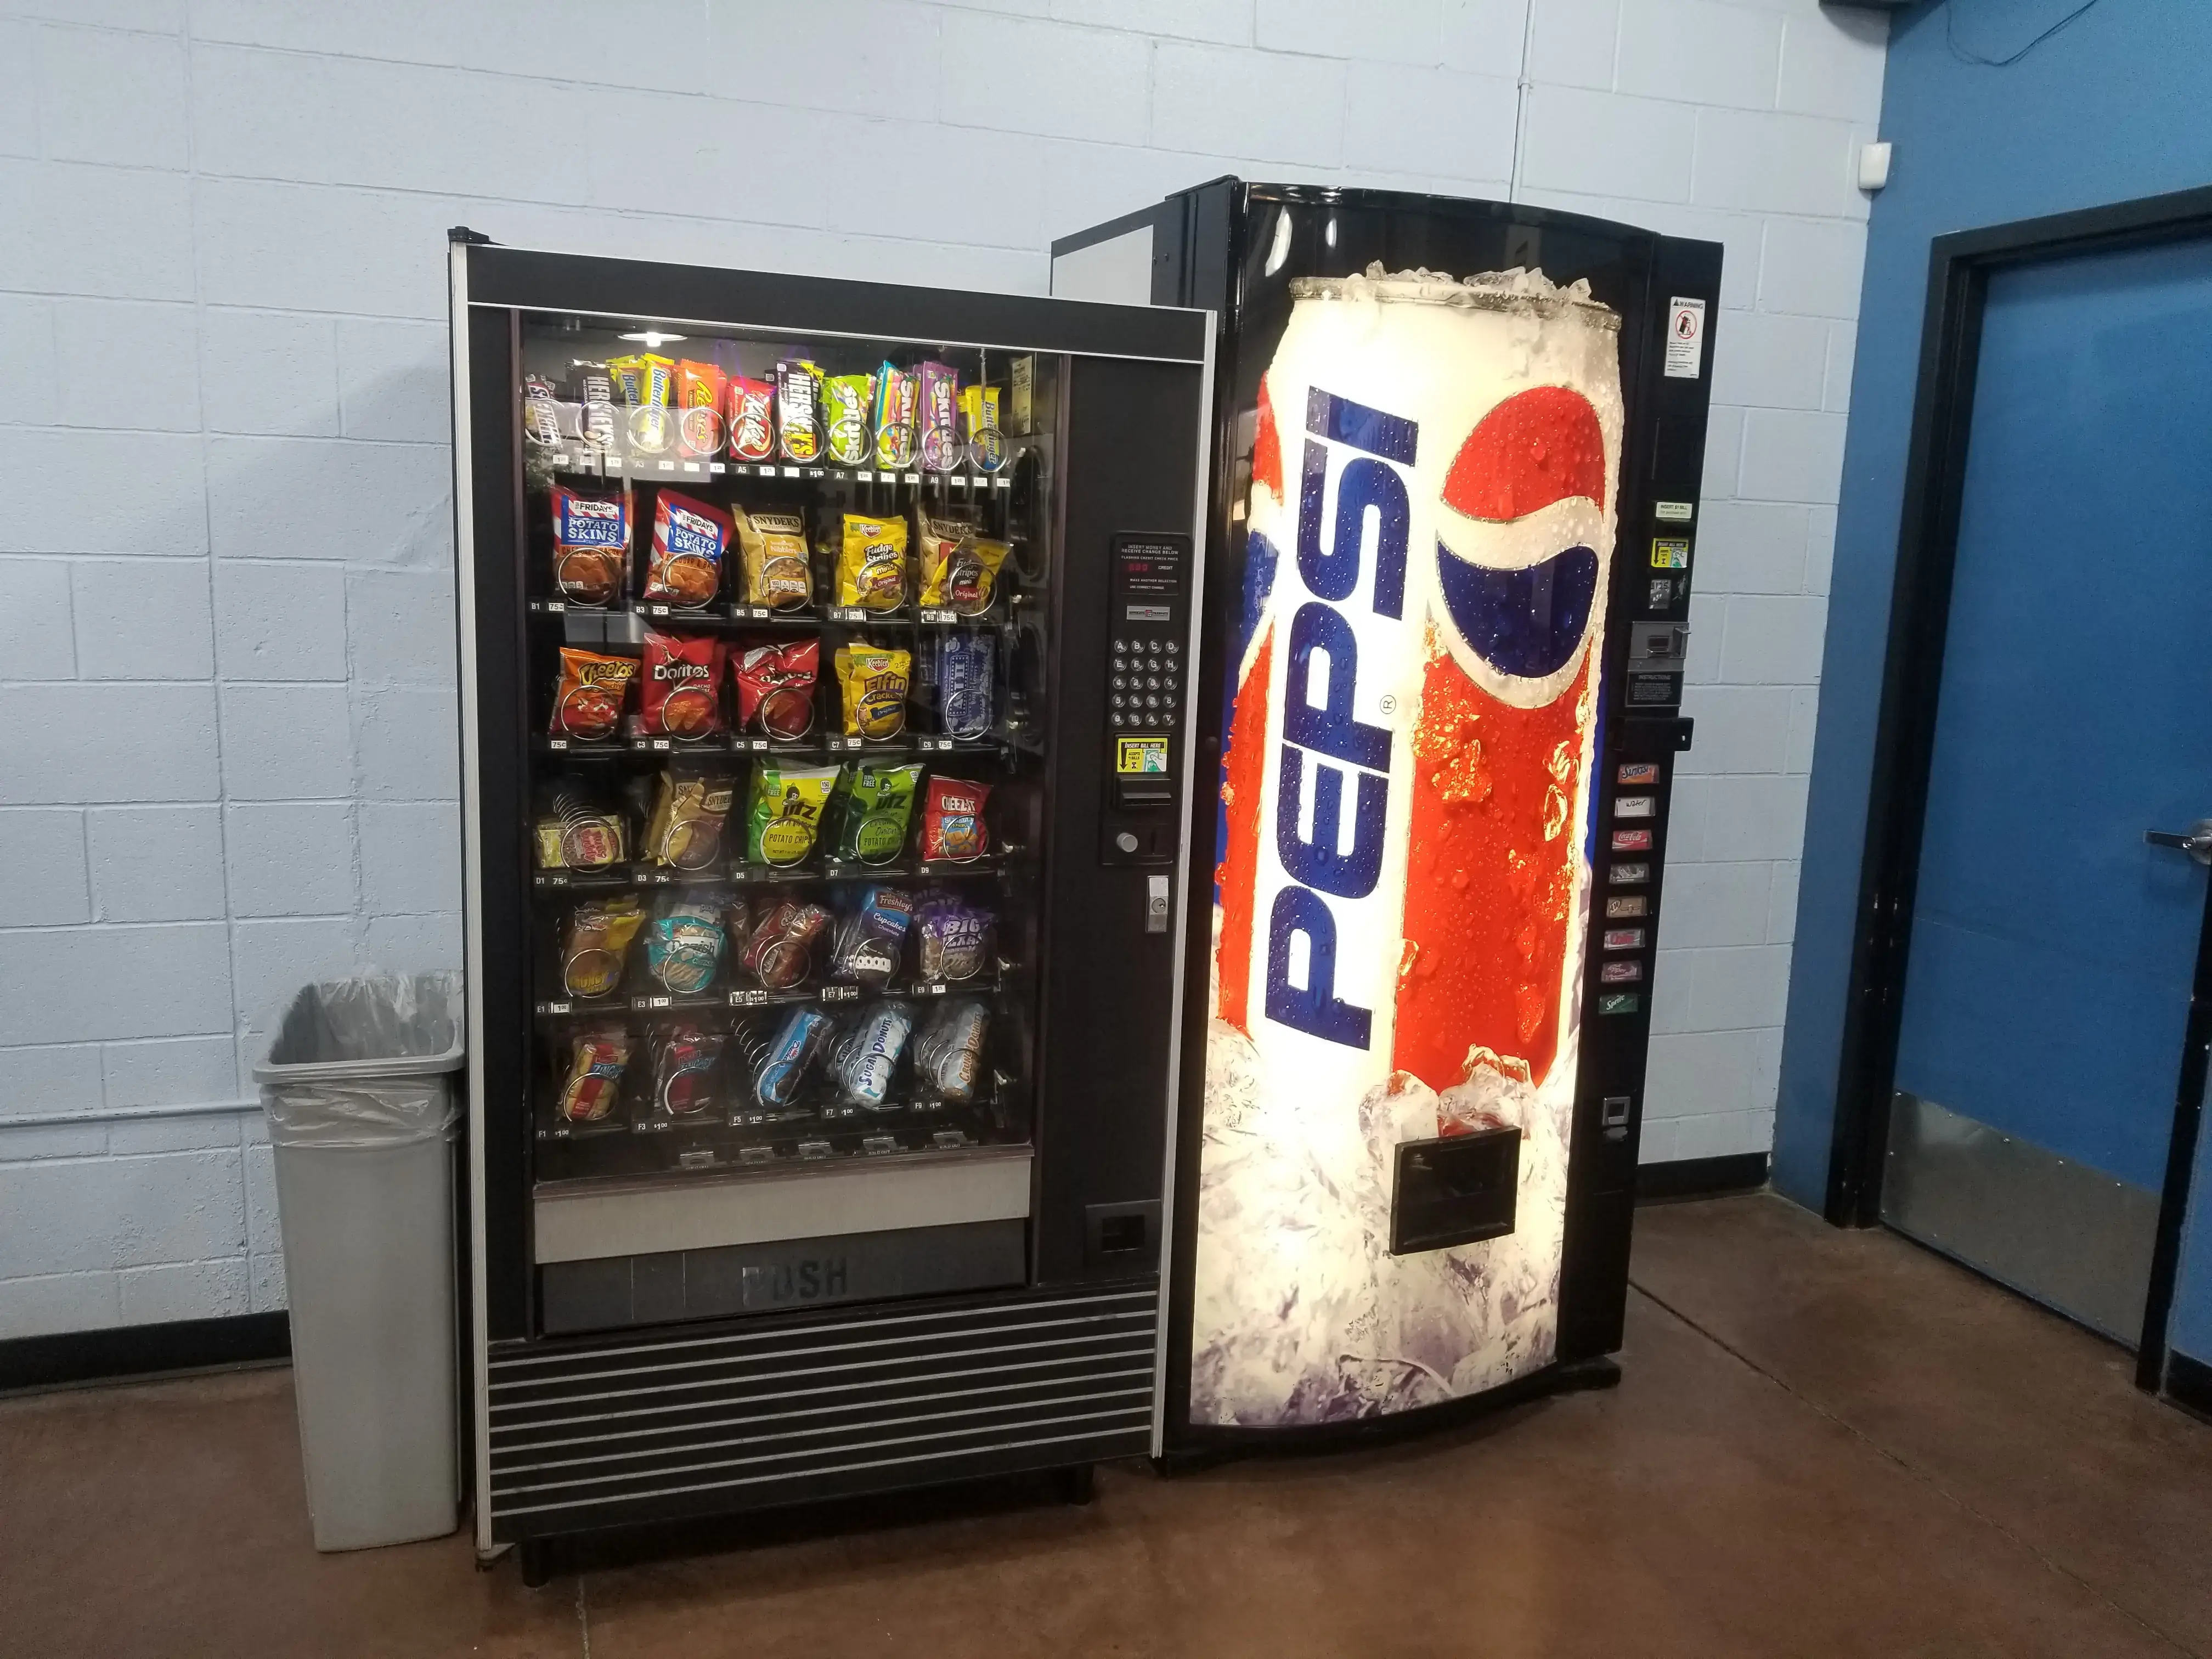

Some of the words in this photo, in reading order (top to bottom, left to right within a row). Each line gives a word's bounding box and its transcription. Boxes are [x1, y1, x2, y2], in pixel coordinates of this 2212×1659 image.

[579, 503, 613, 513] FRIDAYS
[568, 518, 619, 532] POTATO
[686, 516, 714, 533] FRIDAYS
[753, 516, 799, 528] SNYDER'S
[860, 524, 881, 535] Keebler
[568, 527, 618, 543] SKINS
[675, 527, 716, 550] POTATO
[674, 537, 715, 558] SKINS
[865, 543, 893, 557] Fudge
[955, 590, 979, 599] Original
[868, 658, 889, 668] Keebler
[580, 661, 634, 685] Cheetos
[654, 664, 709, 680] Doritos
[866, 673, 905, 692] Elfin
[1263, 386, 1419, 1052] PEPSI
[863, 780, 876, 788] FREE
[769, 833, 793, 844] POTATO
[864, 837, 886, 846] POTATO
[879, 895, 913, 912] Freshley's
[873, 912, 906, 932] Cupcakes
[943, 918, 981, 935] BIG
[1606, 995, 1626, 1011] Sprite
[873, 1017, 893, 1054] DONUTS
[967, 1012, 983, 1049] DONUTS
